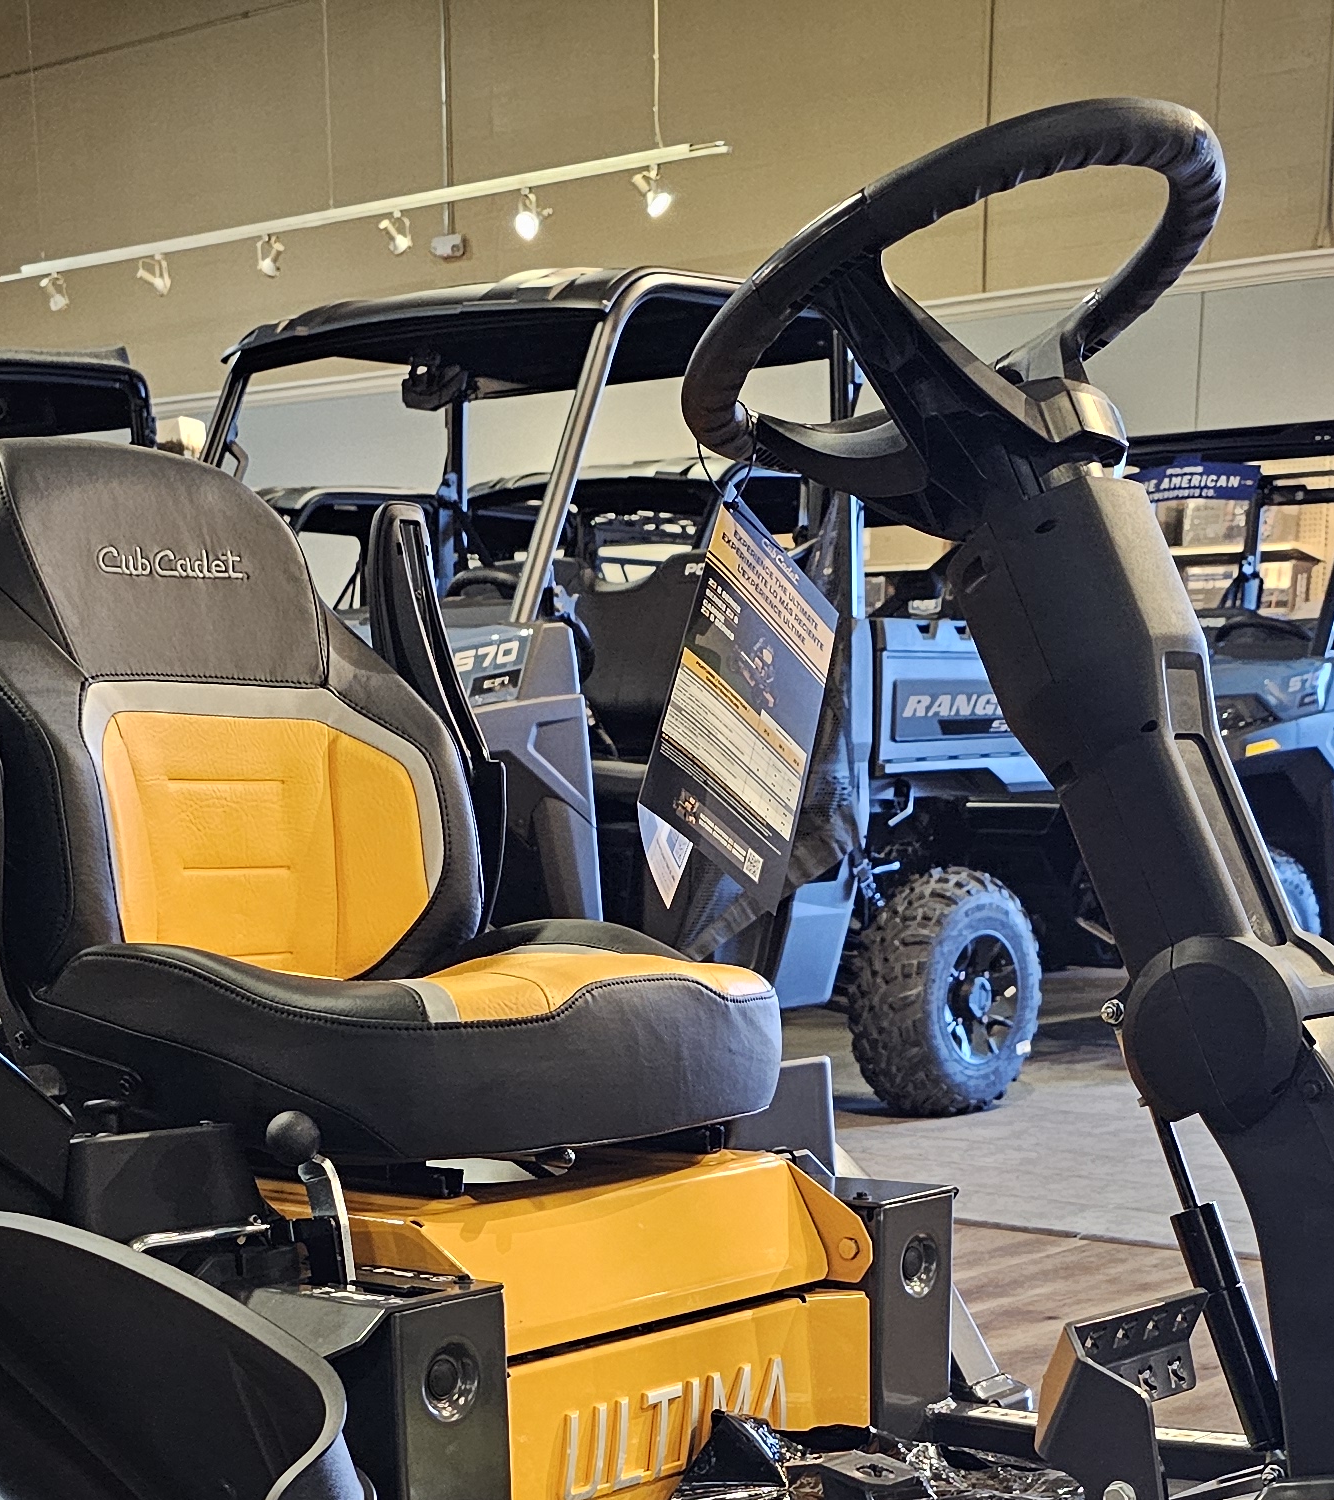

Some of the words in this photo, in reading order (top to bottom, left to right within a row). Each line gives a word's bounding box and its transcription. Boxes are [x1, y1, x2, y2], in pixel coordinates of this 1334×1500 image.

[1159, 474, 1241, 490] AMERICAN
[96, 545, 152, 576] Cub
[153, 548, 244, 579] Cadet
[775, 555, 800, 586] Cadet
[721, 531, 769, 589] EXPERIMENTE
[769, 584, 779, 599] LO
[794, 612, 825, 652] RECIENTE
[733, 529, 774, 580] EXPERIENCE
[775, 576, 788, 595] THE
[788, 592, 819, 632] ULTIMATE
[783, 614, 806, 646] ULTIME
[454, 640, 520, 673] 570
[902, 693, 1003, 718] RANG
